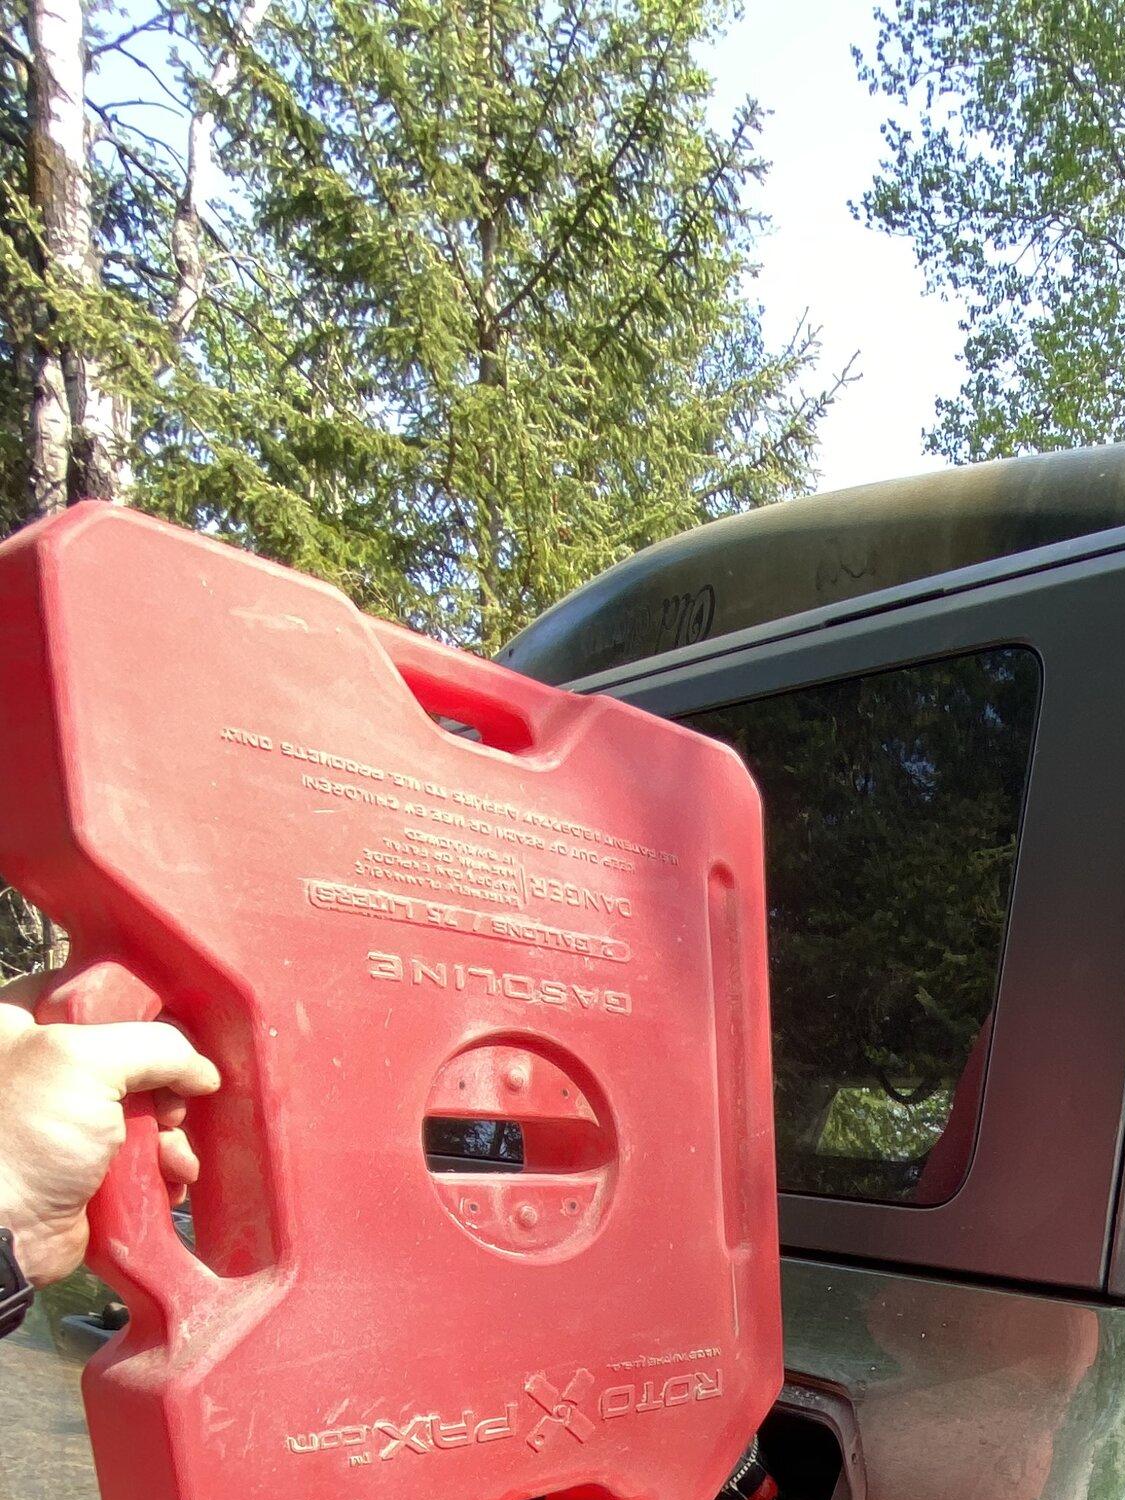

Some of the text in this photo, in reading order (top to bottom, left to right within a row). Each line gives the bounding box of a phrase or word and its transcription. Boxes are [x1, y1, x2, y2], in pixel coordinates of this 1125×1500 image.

[279, 741, 385, 781] PRODUCTS
[302, 773, 399, 811] CHILDREN
[423, 782, 447, 799] TO
[404, 803, 424, 817] BY
[429, 810, 463, 827] USE
[468, 820, 489, 836] OR
[495, 827, 544, 850] REACH
[548, 842, 566, 856] OF
[571, 848, 597, 864] OUT
[434, 866, 462, 881] CAN
[315, 886, 412, 918] LITERS
[530, 875, 631, 918] DANGER
[490, 920, 587, 950] GALLONS
[368, 950, 632, 1016] GASOLINE
[598, 1369, 725, 1421] ROTO
